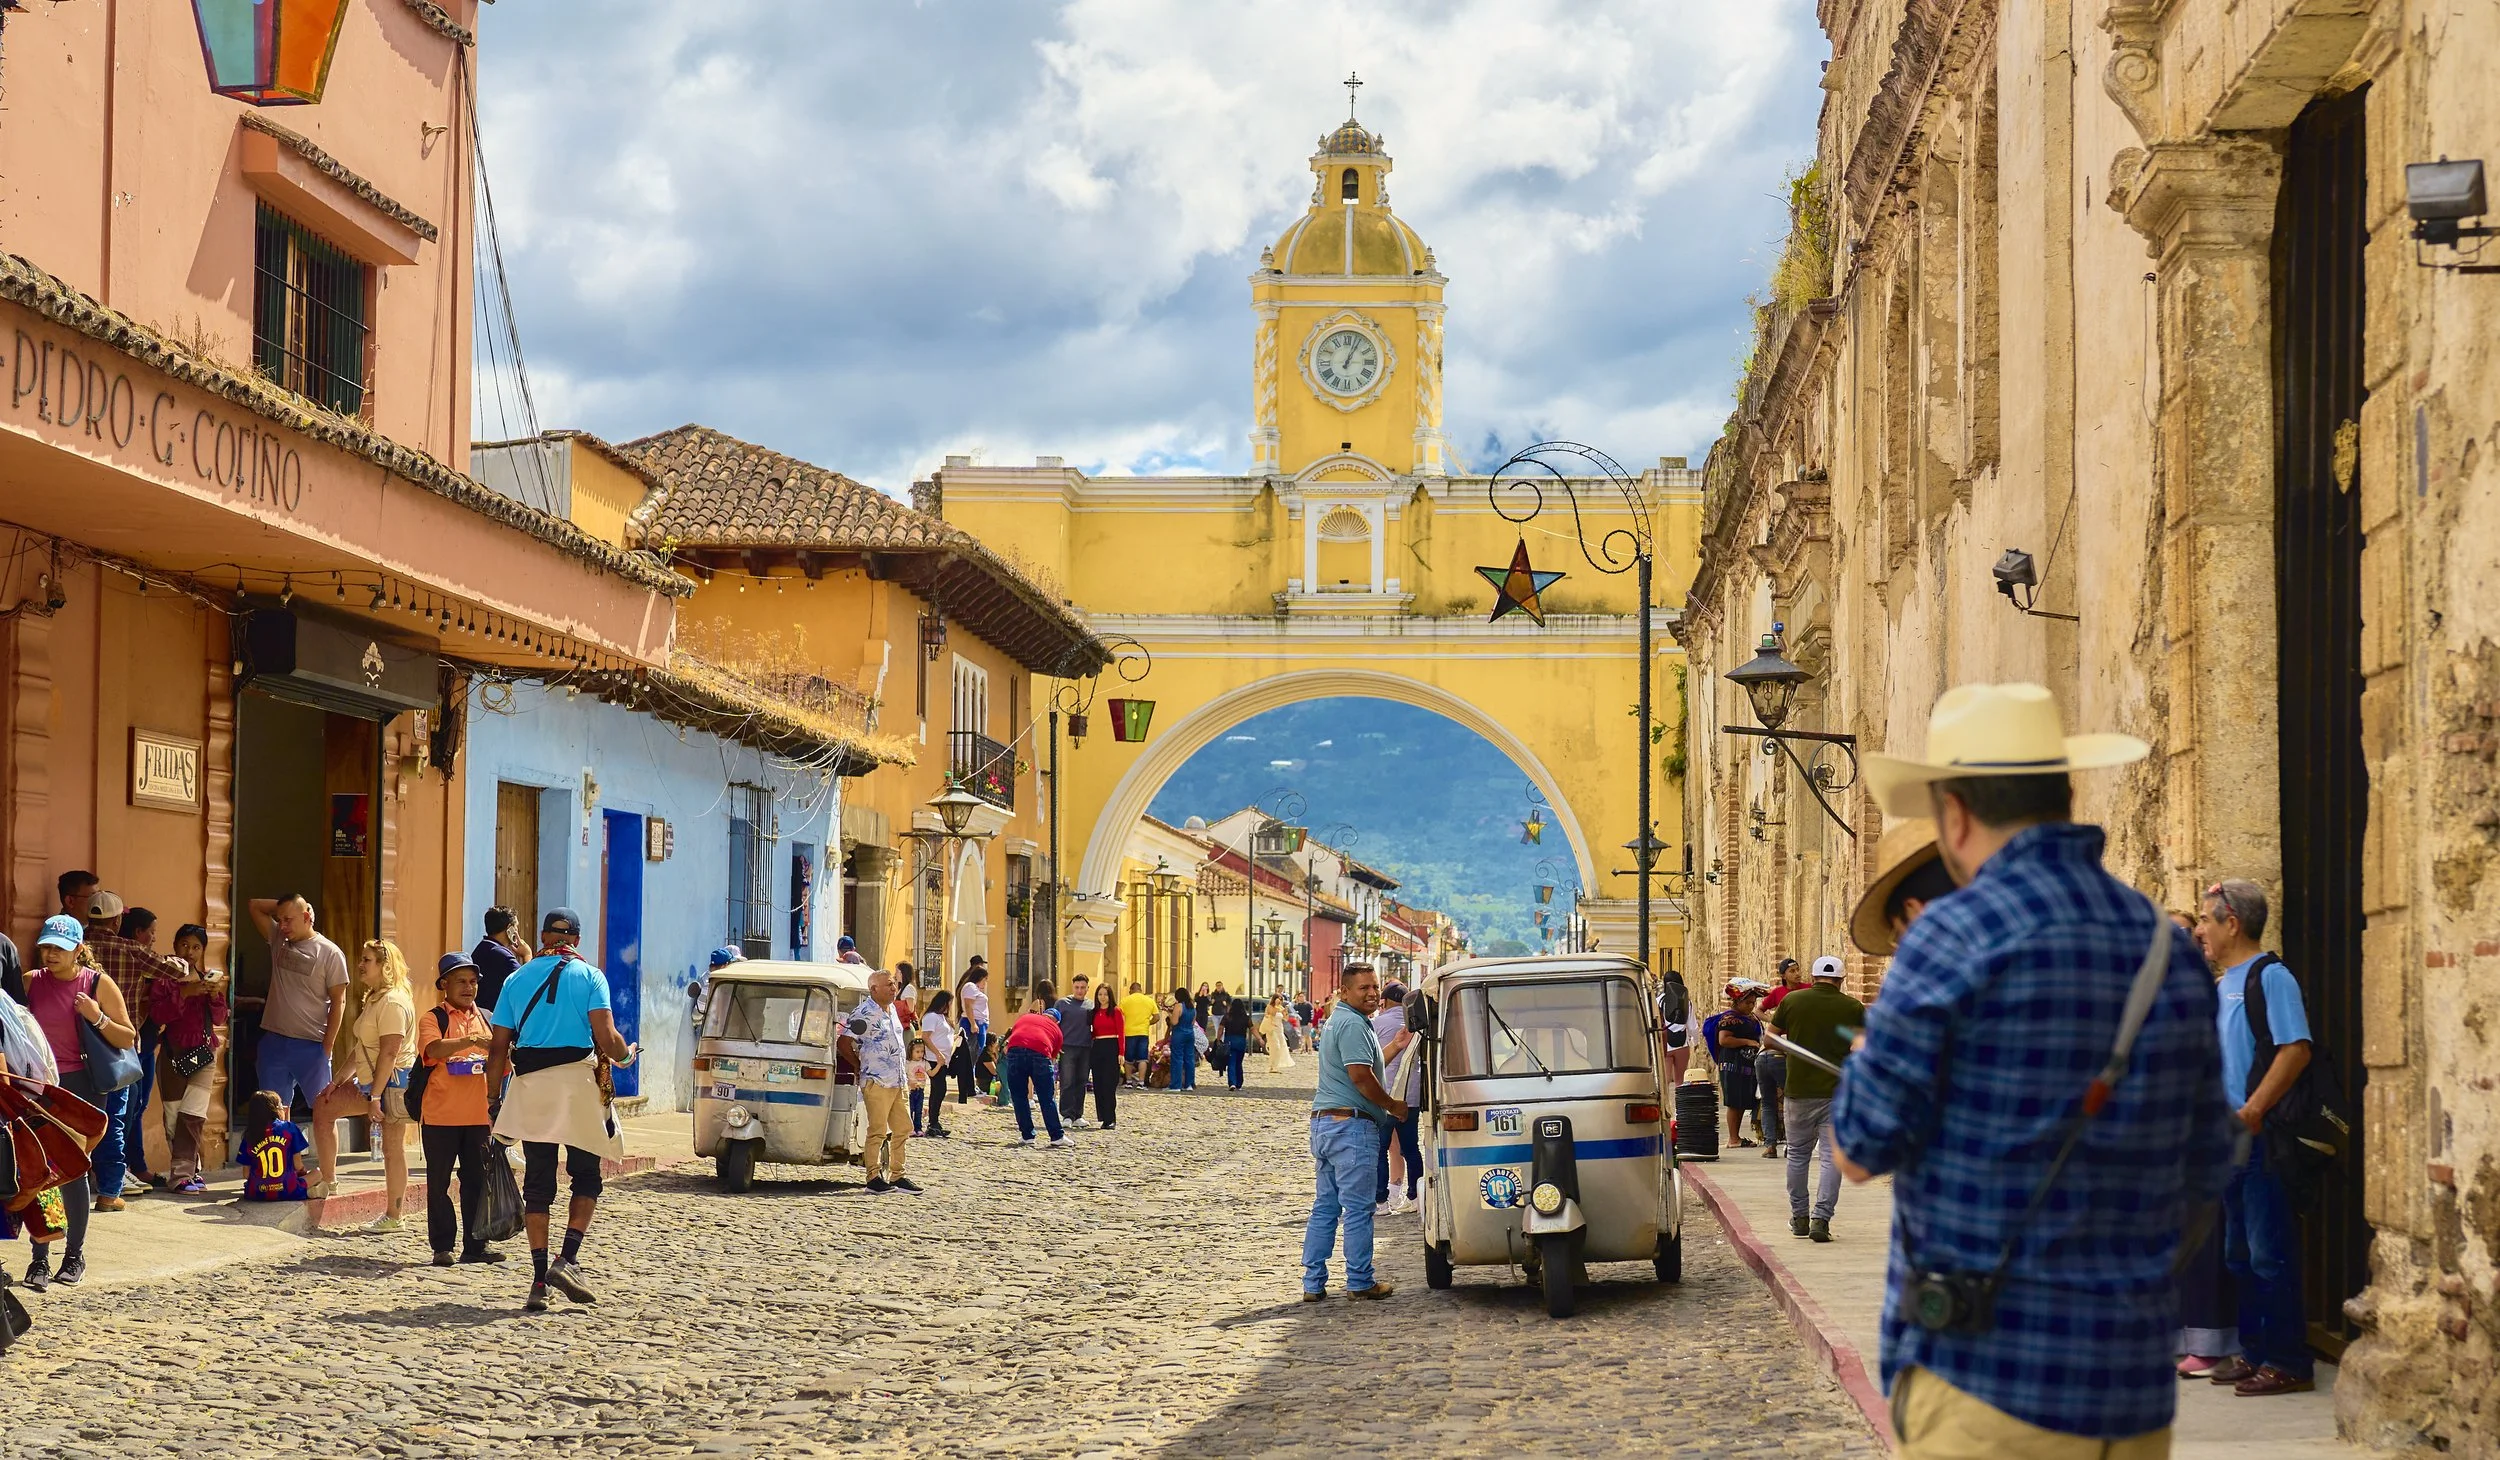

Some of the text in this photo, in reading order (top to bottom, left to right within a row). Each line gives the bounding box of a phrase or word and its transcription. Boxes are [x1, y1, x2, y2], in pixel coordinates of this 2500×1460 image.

[139, 745, 194, 798] FRIDAS
[717, 1086, 729, 1098] 90
[1490, 1108, 1519, 1116] MOTOTAXI
[1492, 1115, 1517, 1132] 161
[1545, 1126, 1559, 1134] RE
[256, 1147, 284, 1178] 10
[1482, 1170, 1496, 1182] TAXI
[1489, 1179, 1510, 1196] 161
